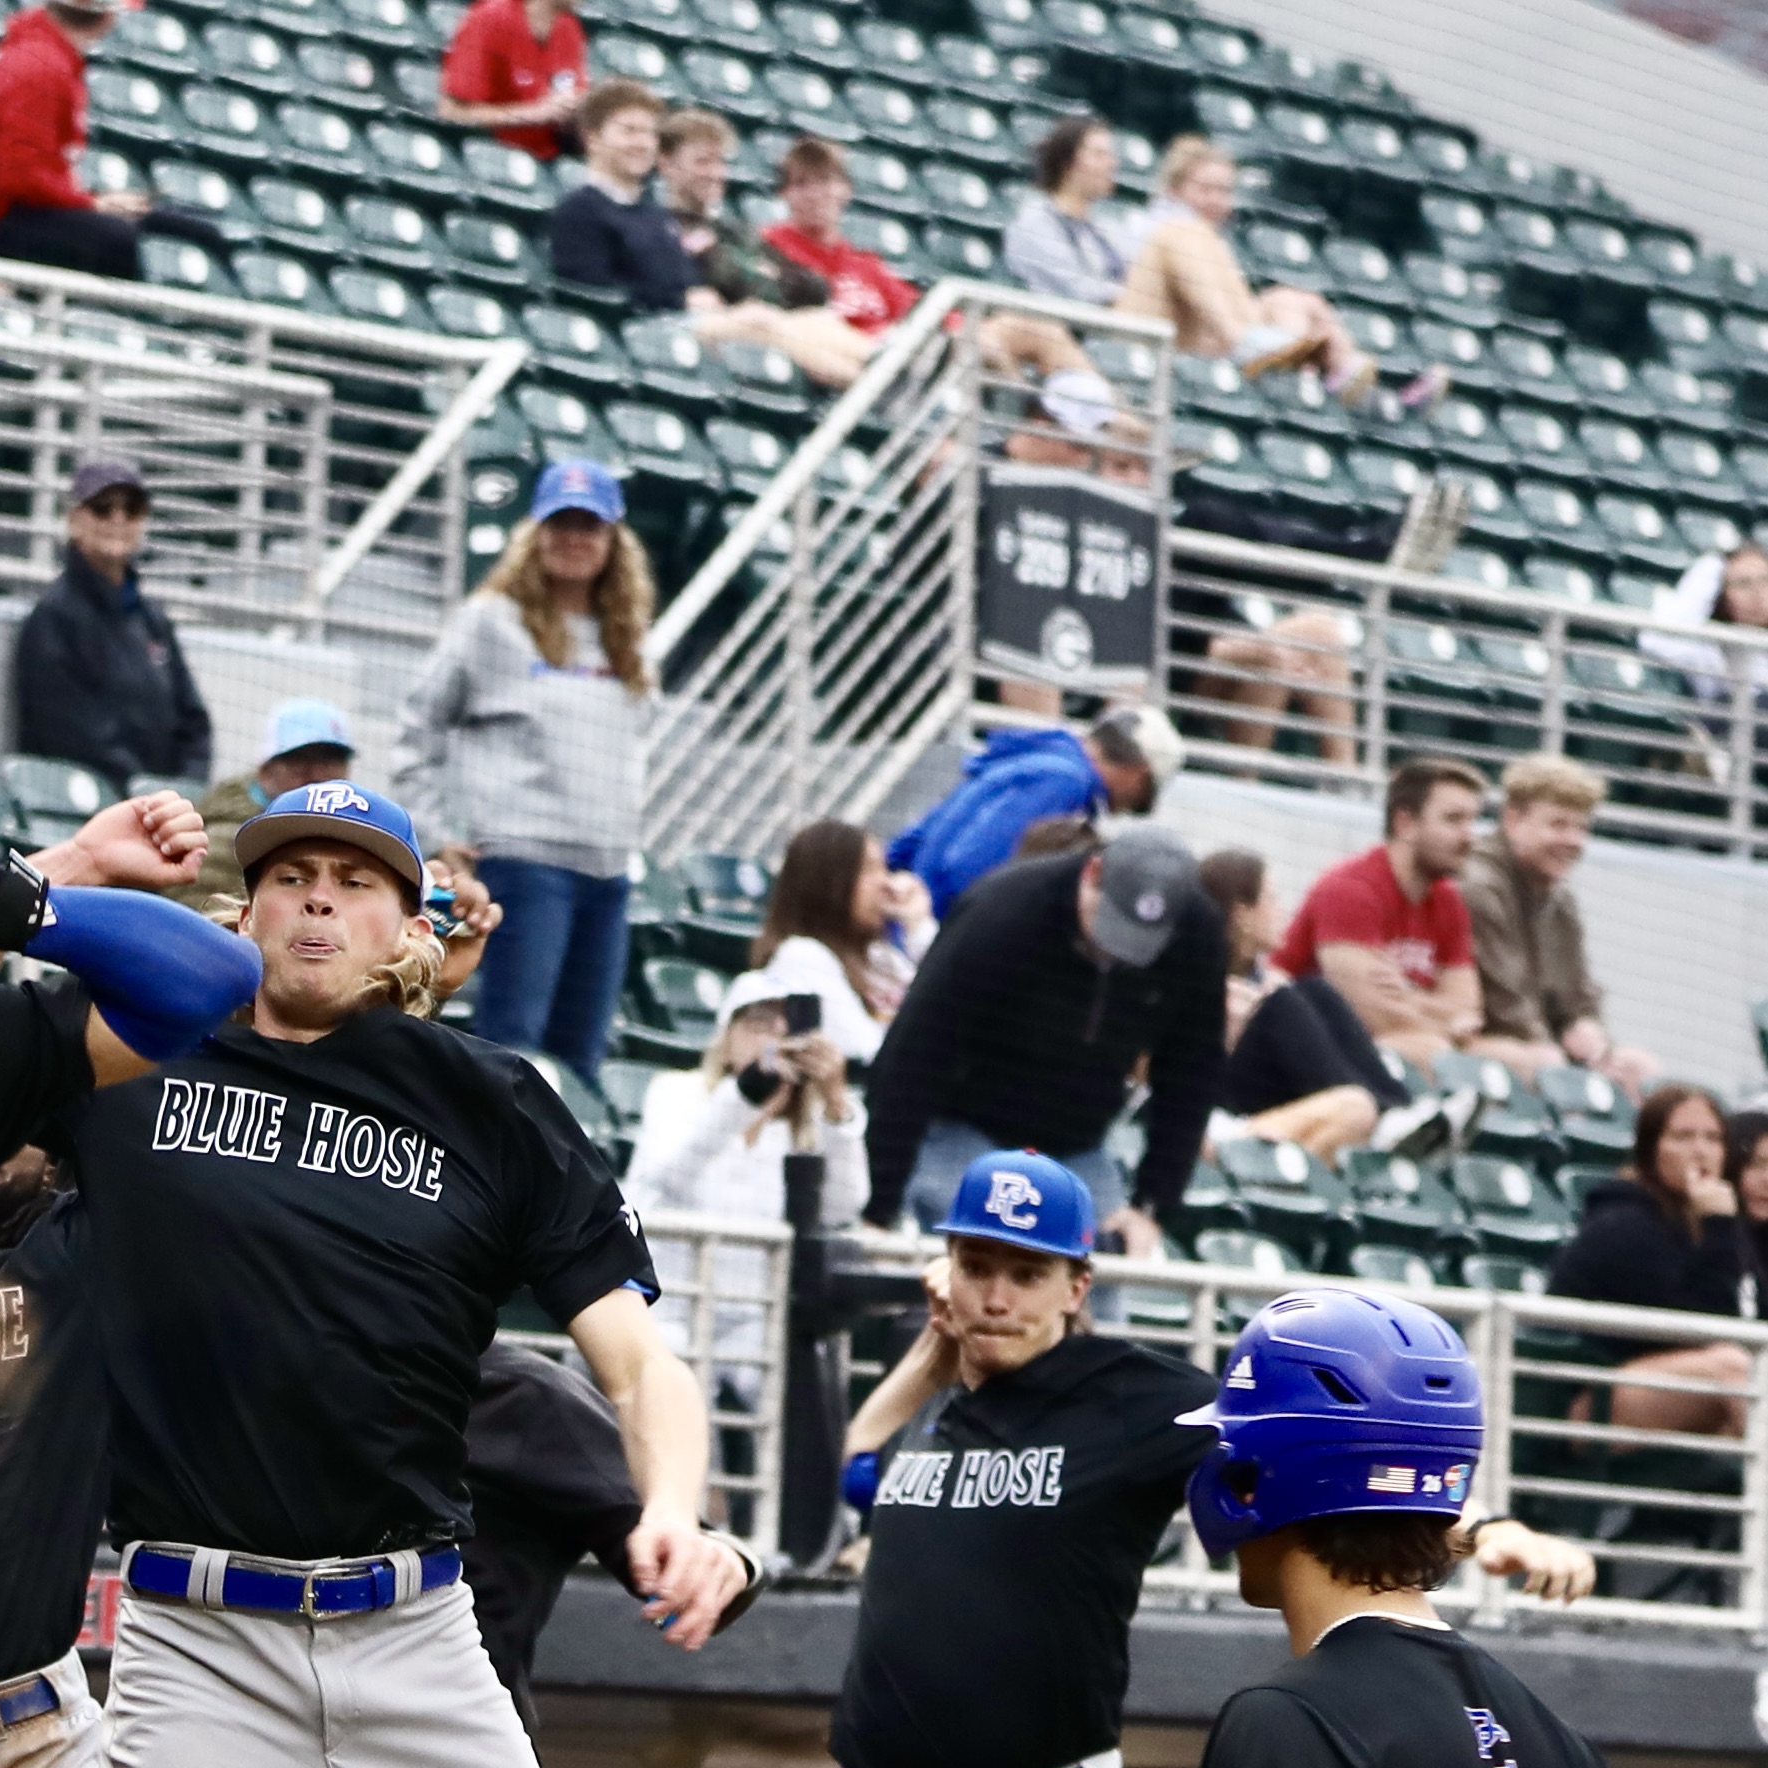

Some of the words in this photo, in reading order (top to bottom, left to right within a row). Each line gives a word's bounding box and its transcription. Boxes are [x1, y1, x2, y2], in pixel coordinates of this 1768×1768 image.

[152, 1077, 288, 1163] BLUE
[297, 1102, 445, 1202] HOSE
[985, 1171, 1043, 1231] PC
[950, 1447, 1065, 1509] HOSE
